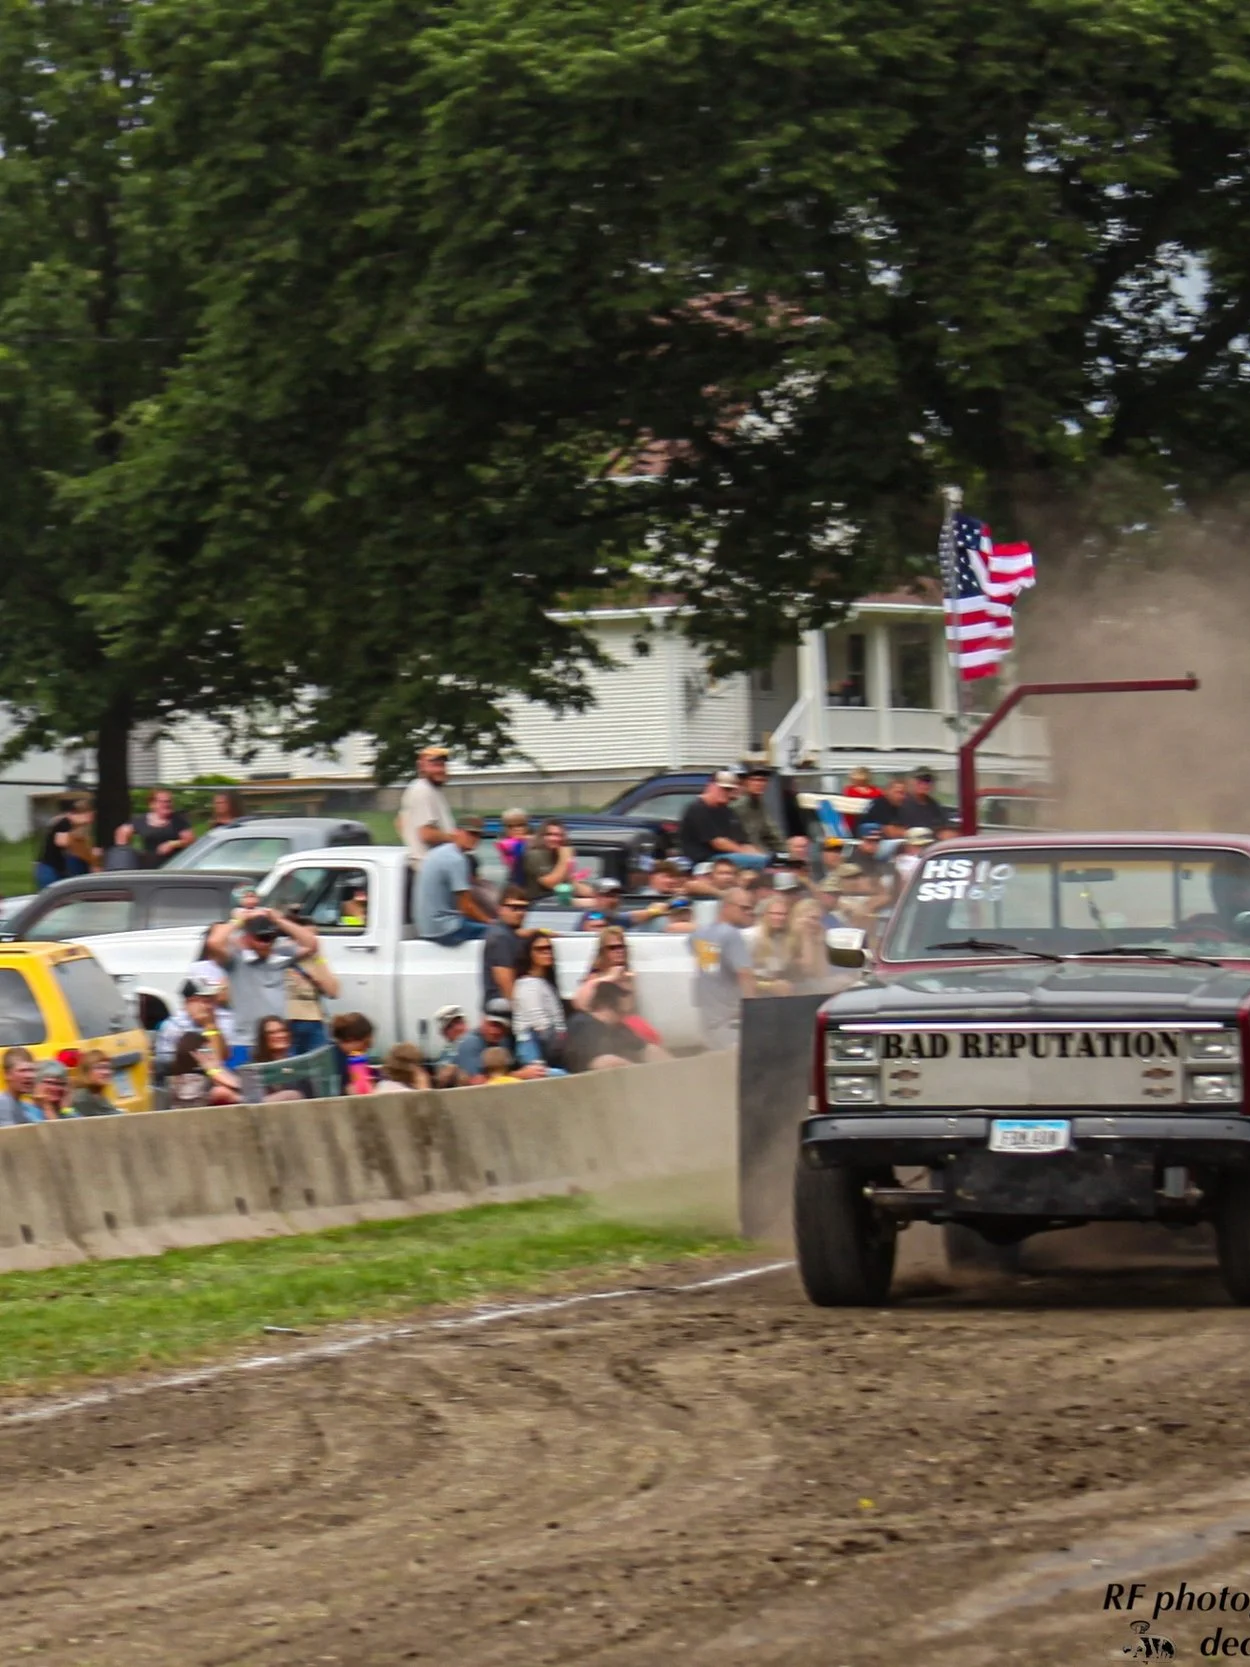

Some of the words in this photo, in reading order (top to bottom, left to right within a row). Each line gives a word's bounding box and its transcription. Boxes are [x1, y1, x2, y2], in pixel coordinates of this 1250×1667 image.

[921, 859, 974, 879] HS
[916, 880, 970, 901] SST
[881, 1031, 950, 1059] BAD
[959, 1030, 1181, 1059] REPUTATION
